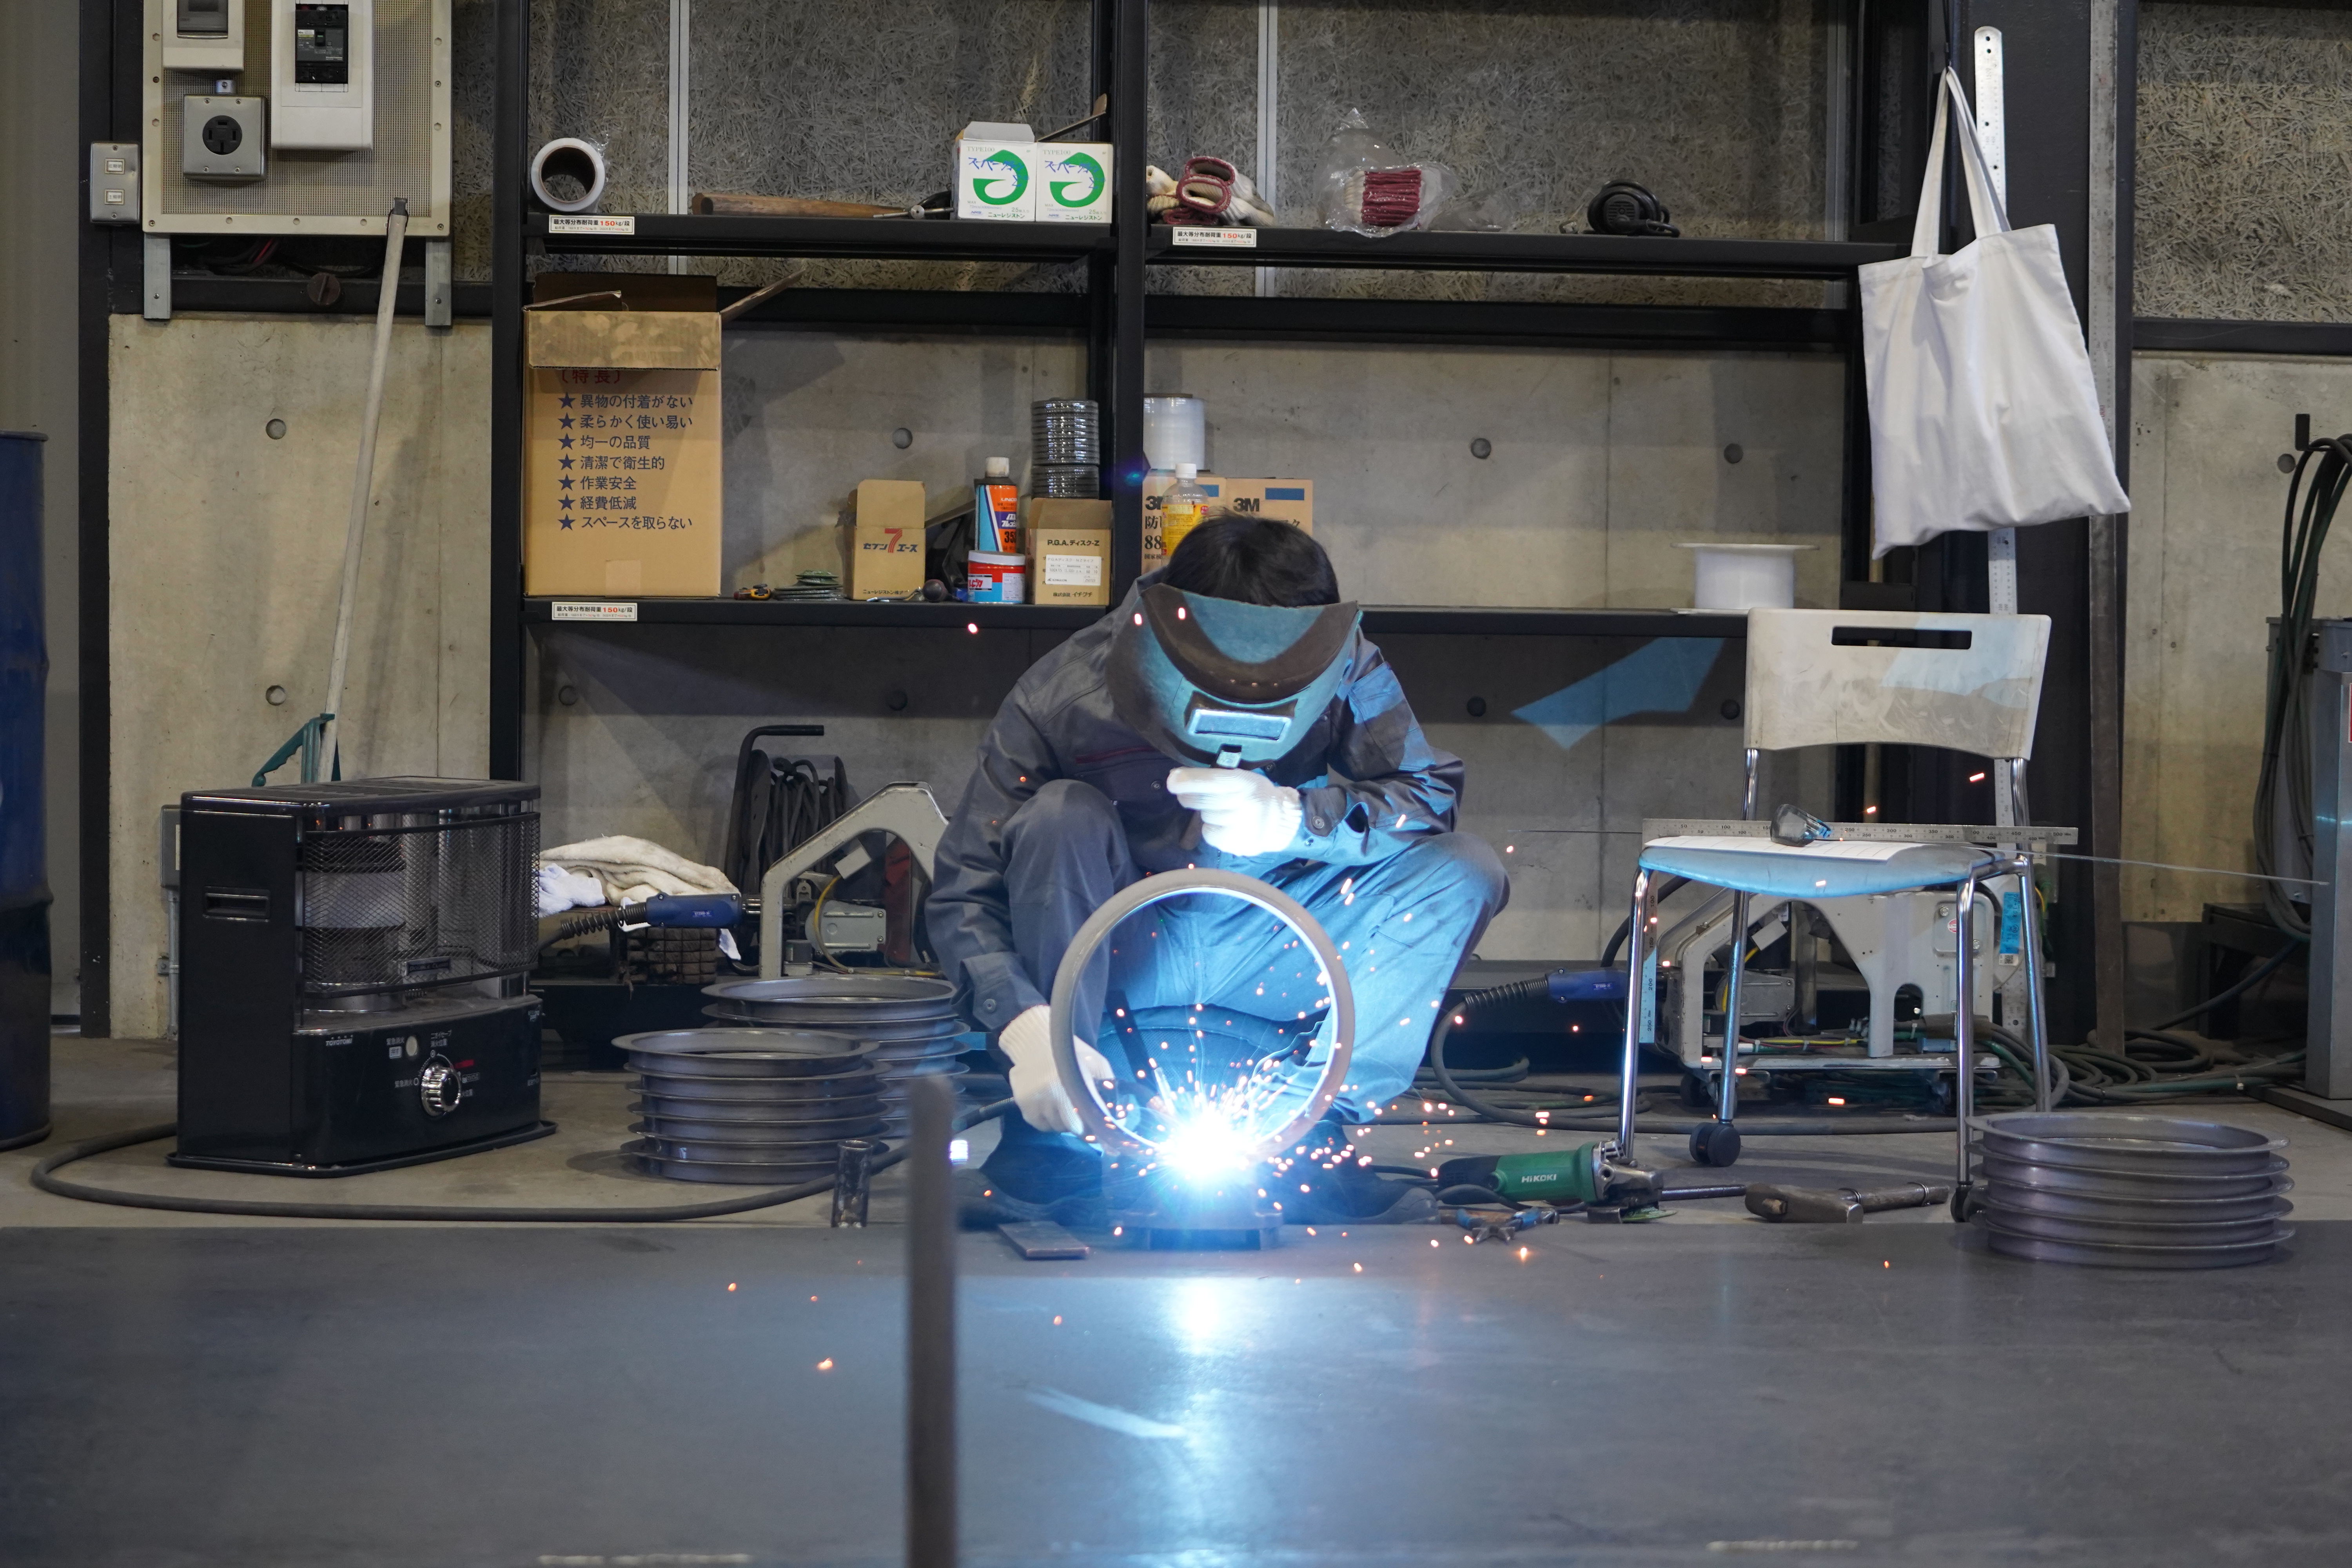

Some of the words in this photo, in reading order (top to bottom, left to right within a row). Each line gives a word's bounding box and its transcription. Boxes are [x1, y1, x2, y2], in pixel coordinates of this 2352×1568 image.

[581, 394, 693, 409] 異物の付着がない
[580, 414, 693, 429] 柔らかく使い易い
[580, 435, 651, 450] 均一の品質
[581, 456, 665, 470] 清潔で衛生的
[580, 475, 637, 490] 作業安全
[580, 496, 637, 511] 経費低減
[1233, 497, 1259, 512] 3M
[581, 515, 693, 530] スペースを取らない
[884, 528, 902, 553] 7
[1004, 530, 1016, 543] 35
[897, 544, 918, 552] エース
[325, 1038, 352, 1046] TOYOTOMI
